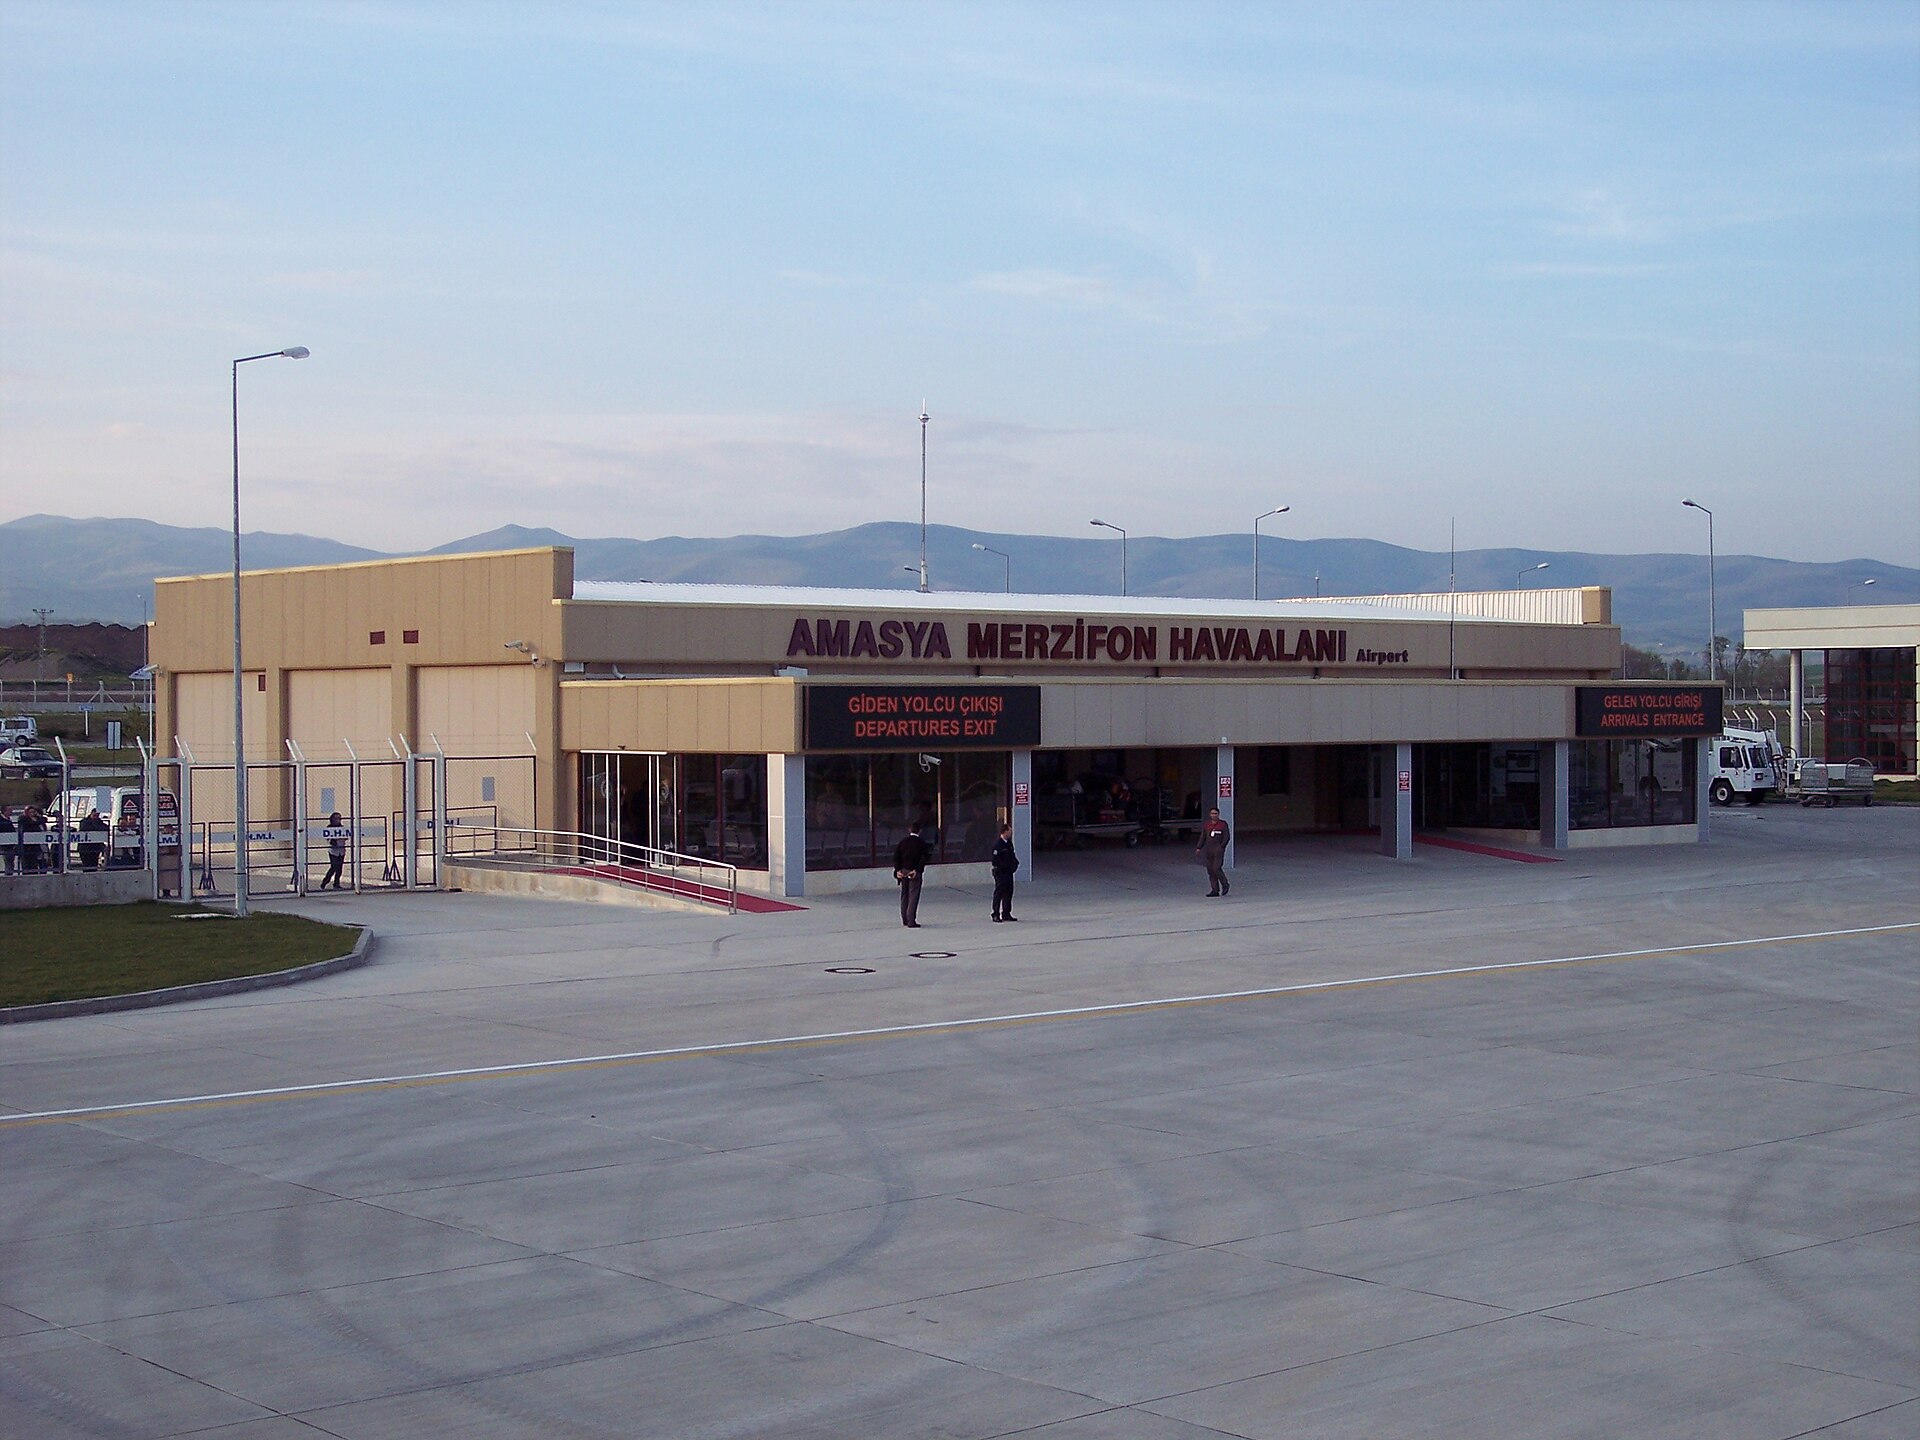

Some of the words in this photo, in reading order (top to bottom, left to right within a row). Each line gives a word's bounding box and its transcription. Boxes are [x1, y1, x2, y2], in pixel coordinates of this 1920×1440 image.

[786, 618, 951, 657] AMASYA
[967, 618, 1157, 661] MERZİFON
[1169, 627, 1347, 662] HAVAALANI
[1355, 648, 1409, 665] Airport
[848, 693, 898, 713] GİDEN
[902, 696, 956, 712] YOLCU
[959, 696, 1003, 716] ÇIKIŞI
[1604, 695, 1637, 708] GELEN
[1640, 695, 1672, 708] YOLCU
[855, 719, 960, 737] DEPARTURES
[964, 719, 997, 735] EXIT
[1600, 713, 1649, 727] ARRIVALS
[1653, 713, 1705, 726] ENTRANCE
